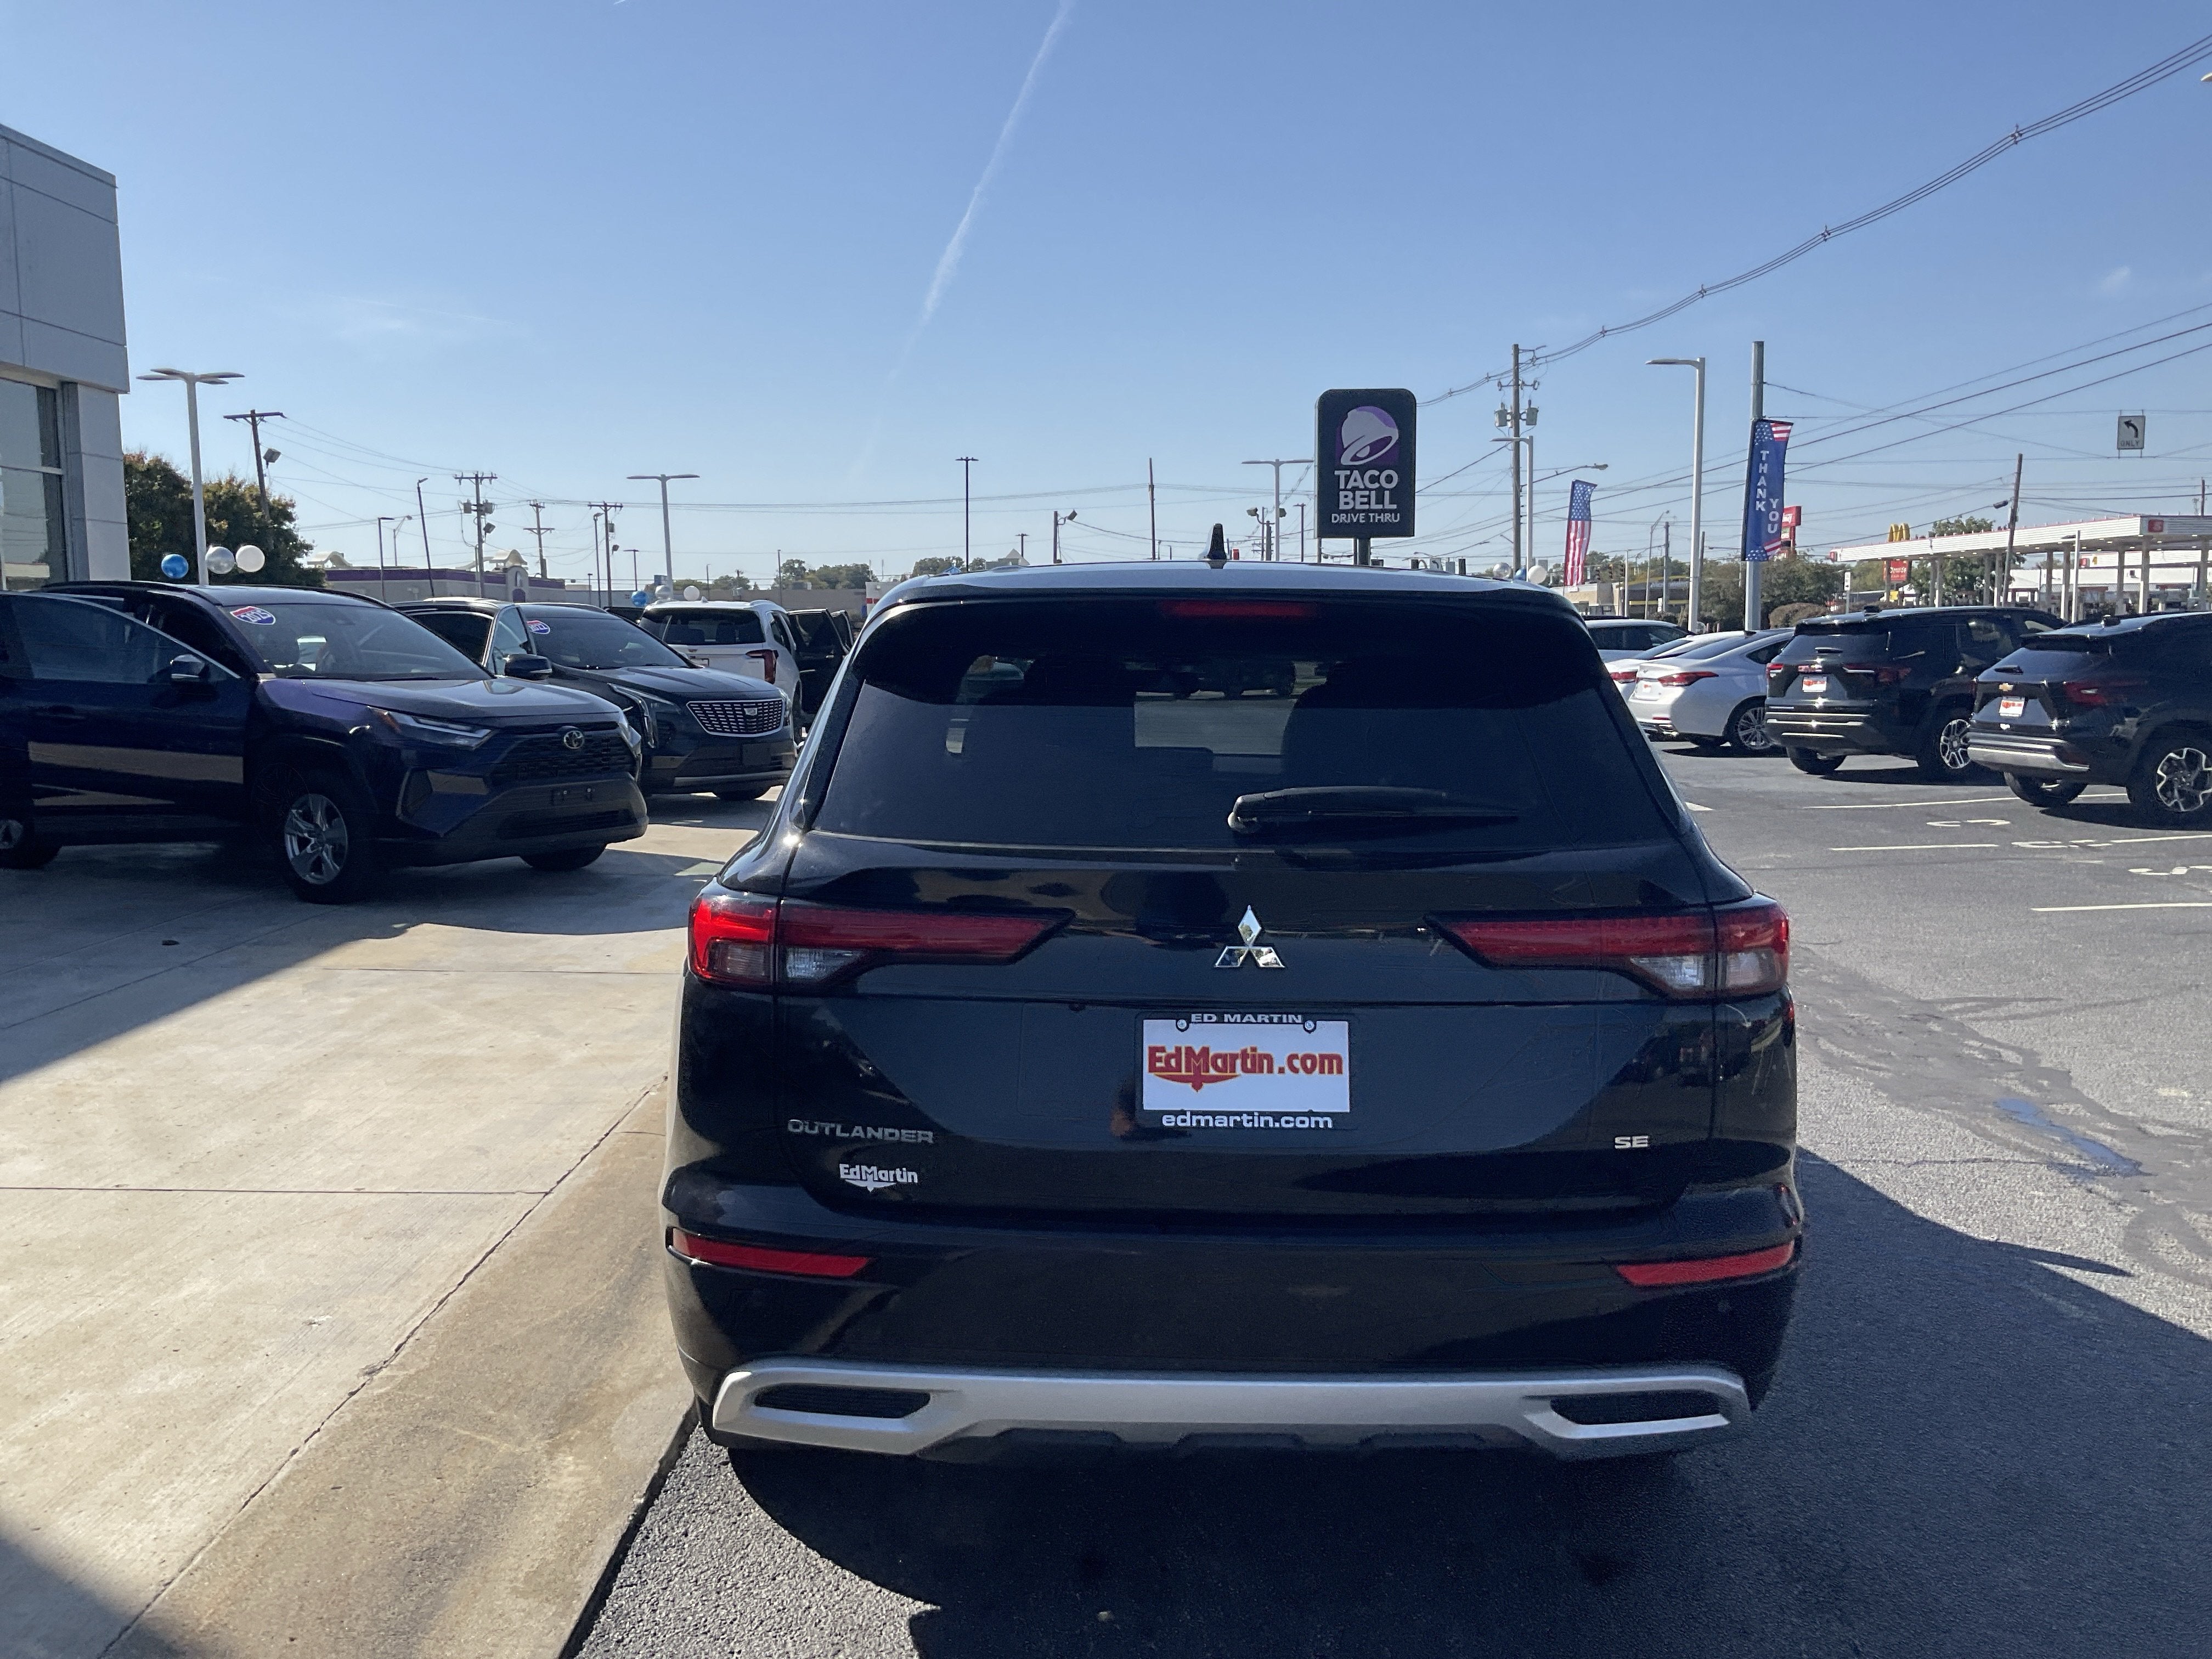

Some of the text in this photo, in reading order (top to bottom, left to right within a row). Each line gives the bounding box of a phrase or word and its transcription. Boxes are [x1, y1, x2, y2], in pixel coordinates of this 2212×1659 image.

[1334, 470, 1398, 489] TACO
[1756, 450, 1769, 511] THANK
[1339, 490, 1397, 510] BELL
[1331, 512, 1400, 524] DRIVE THRU
[1767, 498, 1780, 534] YOU
[240, 610, 272, 622] 2025
[1191, 1013, 1302, 1023] ED MARTIN
[1148, 1045, 1344, 1075] EdMartin.com
[1162, 1111, 1333, 1128] edmartin.com
[788, 1119, 934, 1143] OUTLANDER
[1615, 1135, 1649, 1149] SE
[839, 1163, 918, 1184] EdMartin
